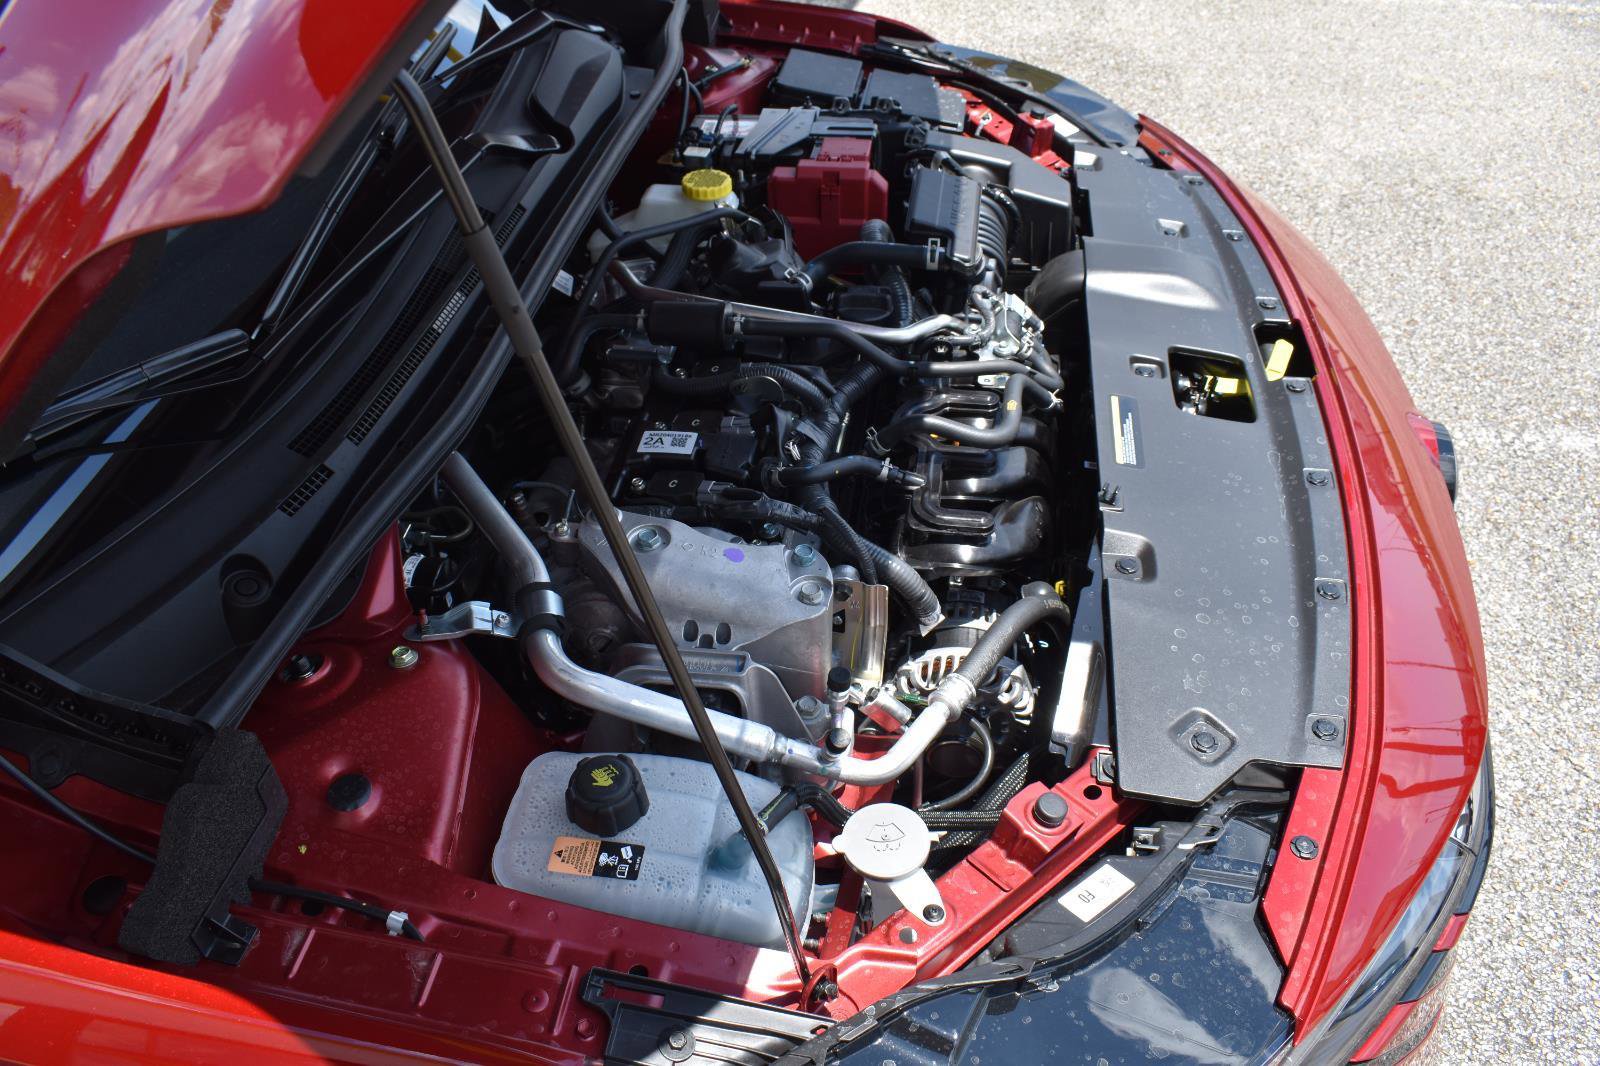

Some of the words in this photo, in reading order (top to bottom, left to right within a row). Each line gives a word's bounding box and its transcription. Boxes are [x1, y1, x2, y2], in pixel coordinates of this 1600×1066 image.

[691, 419, 700, 427] C
[643, 437, 665, 446] 2A
[668, 479, 679, 488] C
